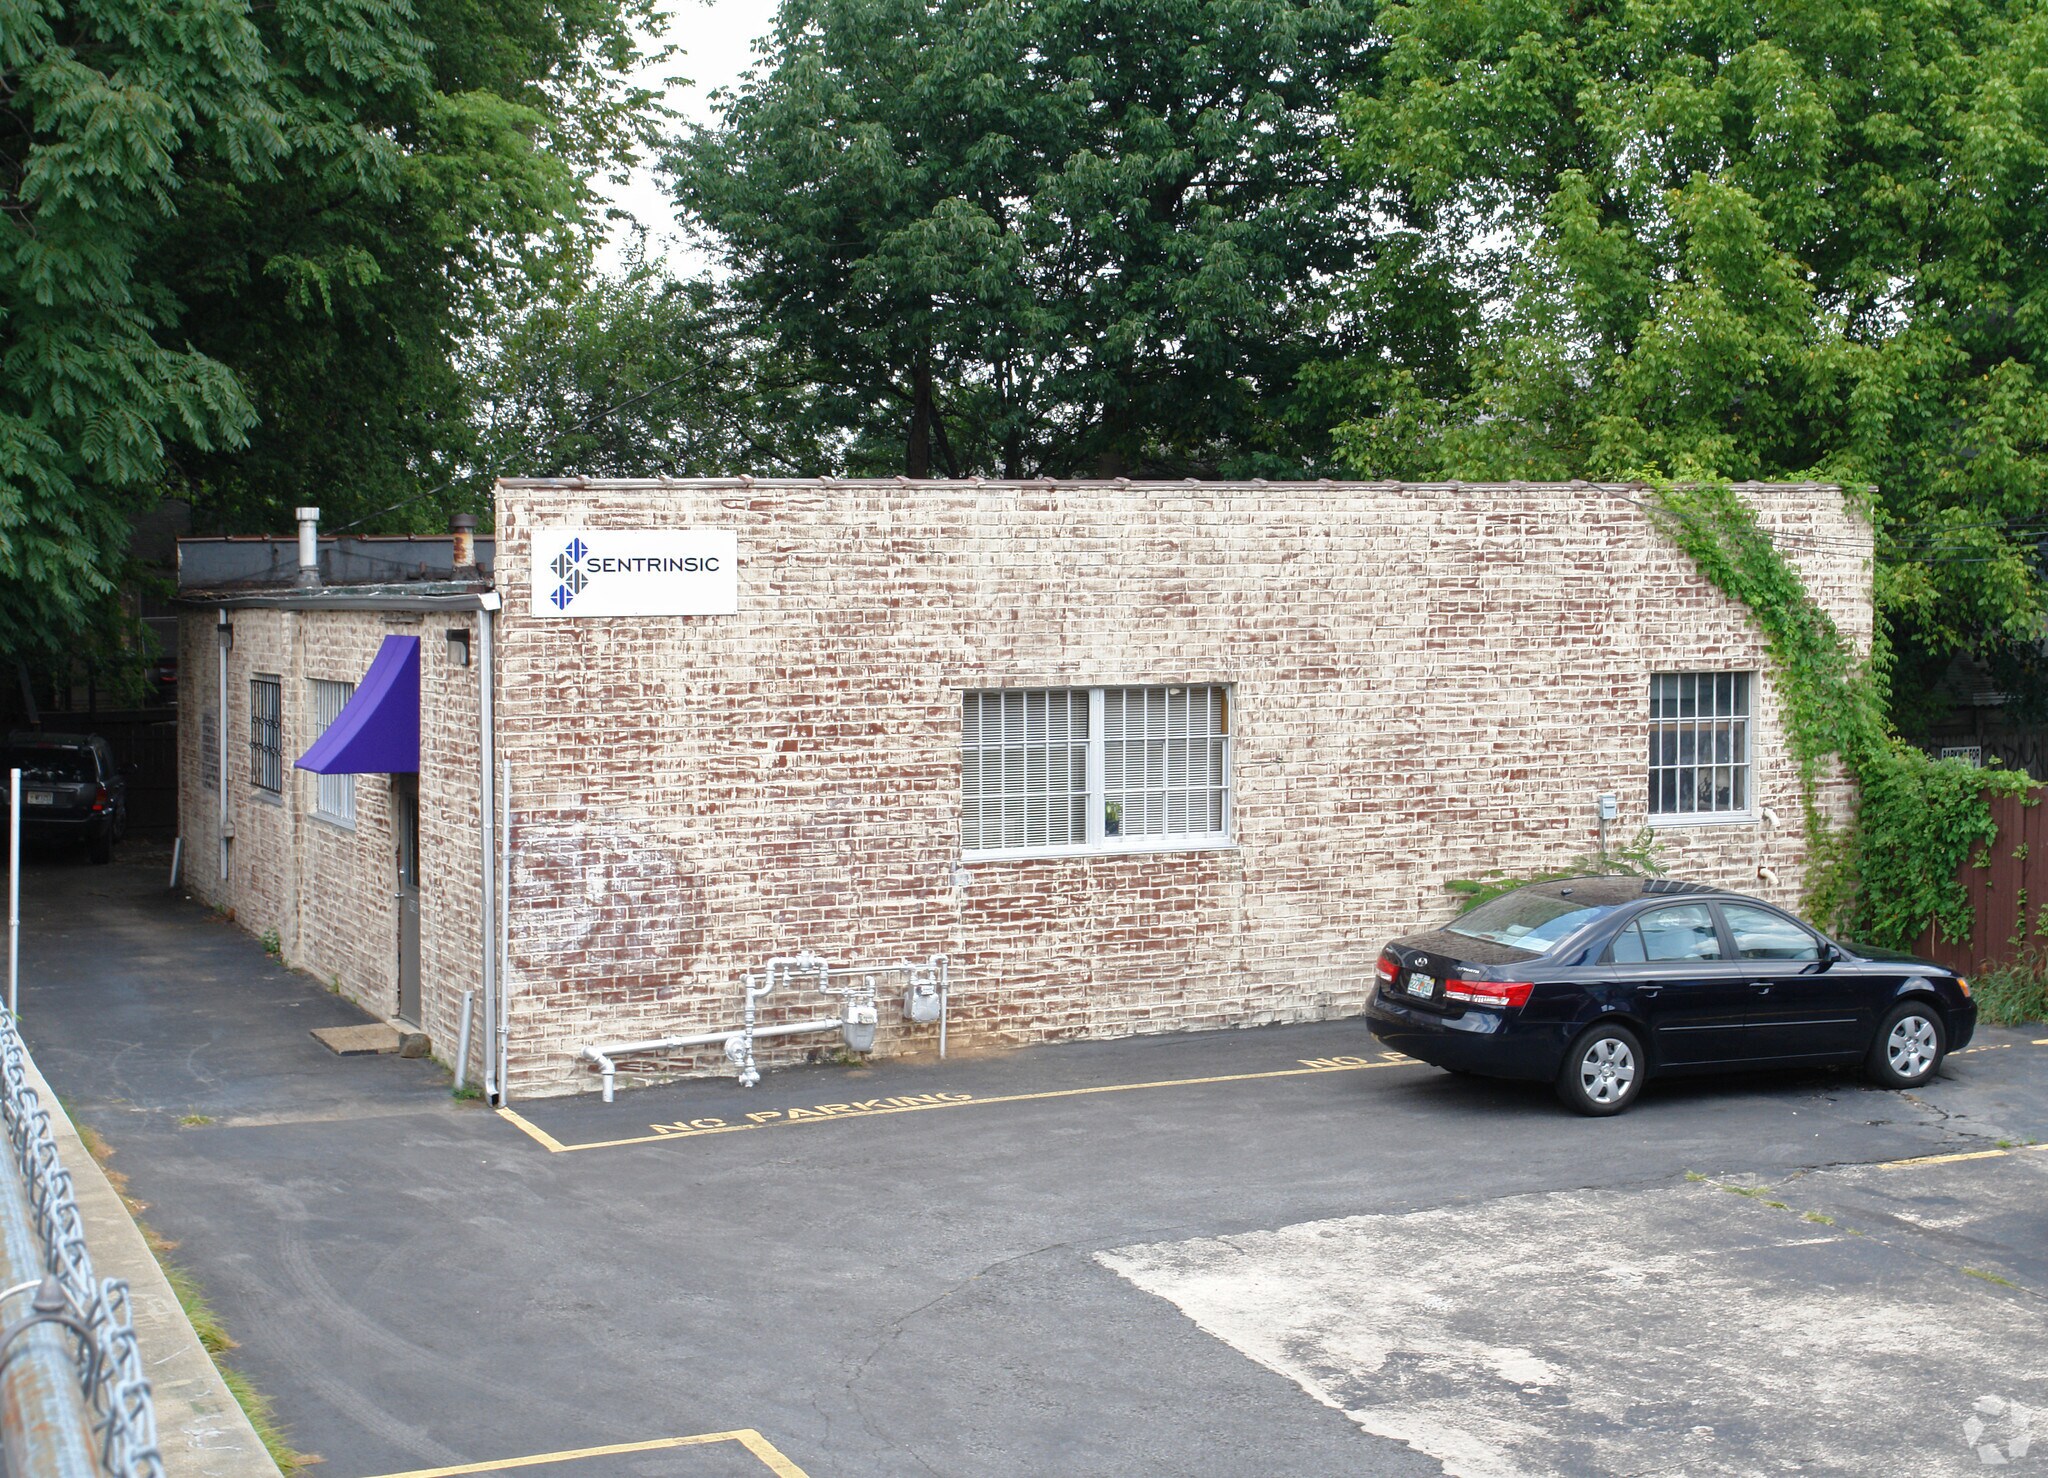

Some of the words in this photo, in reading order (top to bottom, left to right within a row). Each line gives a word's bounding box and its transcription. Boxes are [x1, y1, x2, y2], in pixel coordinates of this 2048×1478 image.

[586, 557, 720, 573] SENTRINSIC
[1969, 748, 1980, 760] FOR
[1297, 1056, 1367, 1069] NO
[650, 1117, 727, 1135] NO
[745, 1092, 973, 1123] PARKING
